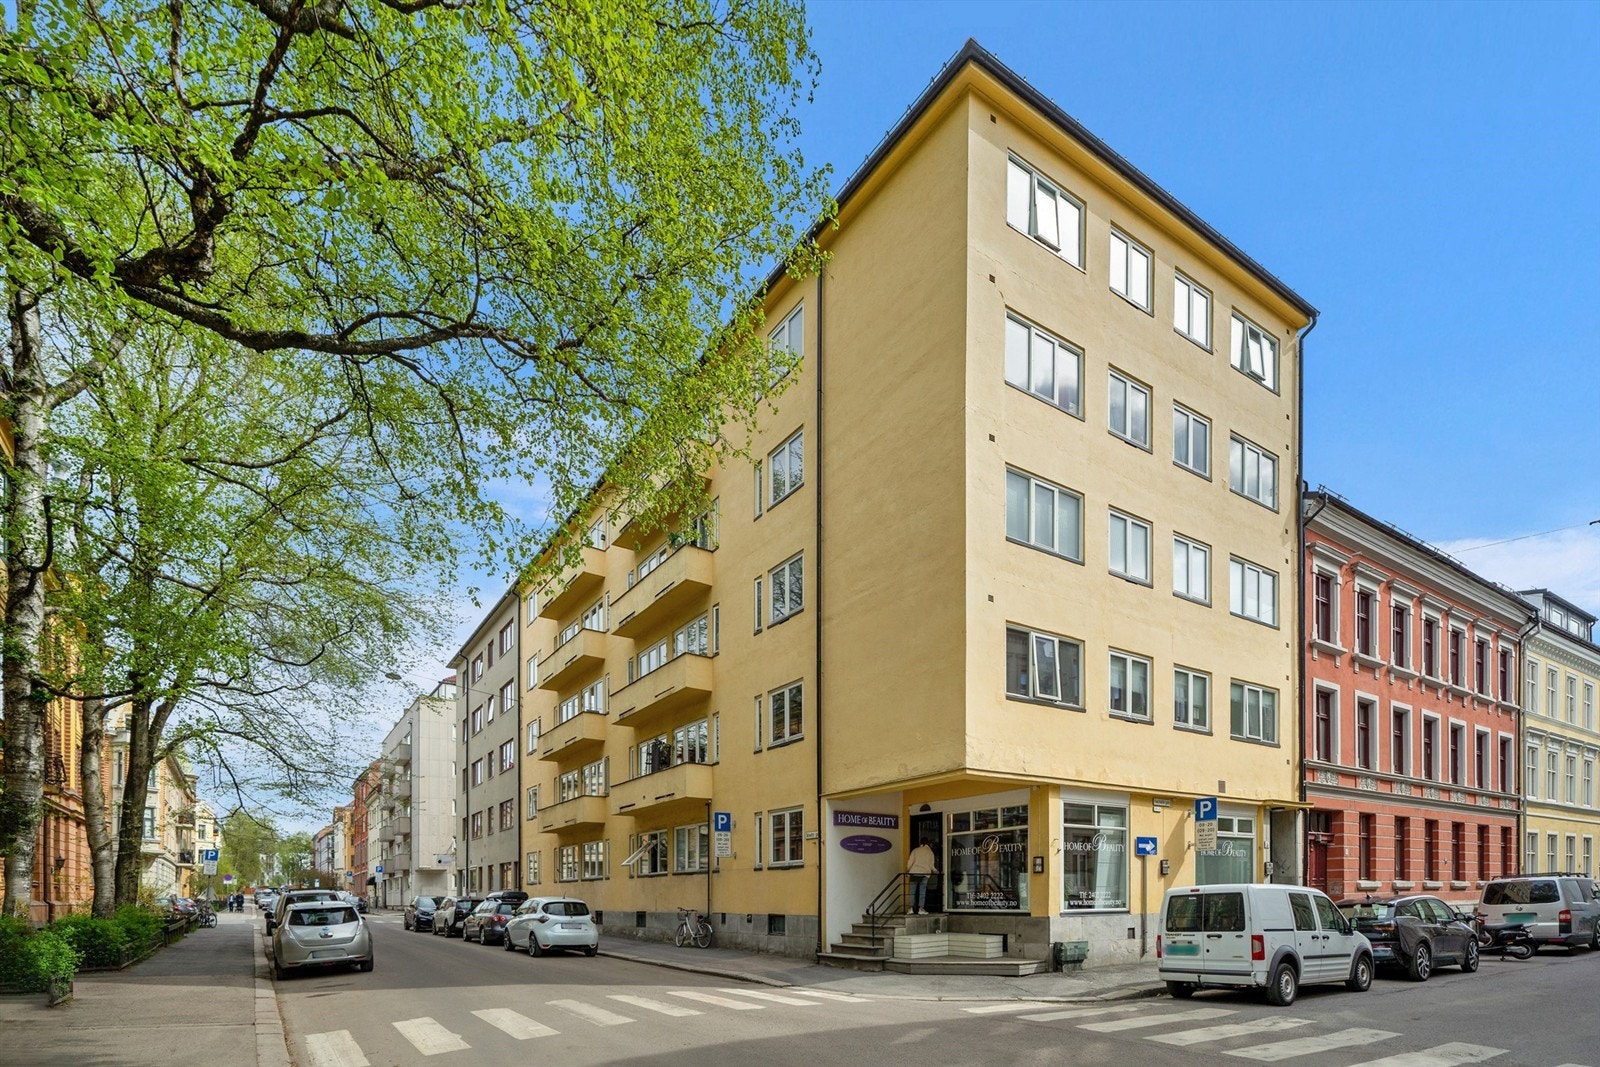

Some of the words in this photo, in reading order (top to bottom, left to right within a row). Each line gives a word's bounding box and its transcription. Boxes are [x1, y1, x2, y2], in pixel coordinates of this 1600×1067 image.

[1200, 801, 1212, 819] P
[718, 814, 727, 829] P
[838, 813, 862, 824] HOME
[868, 816, 896, 827] BEAUTY
[207, 850, 217, 860] P
[956, 899, 1018, 908] www.homeofbeauty.no
